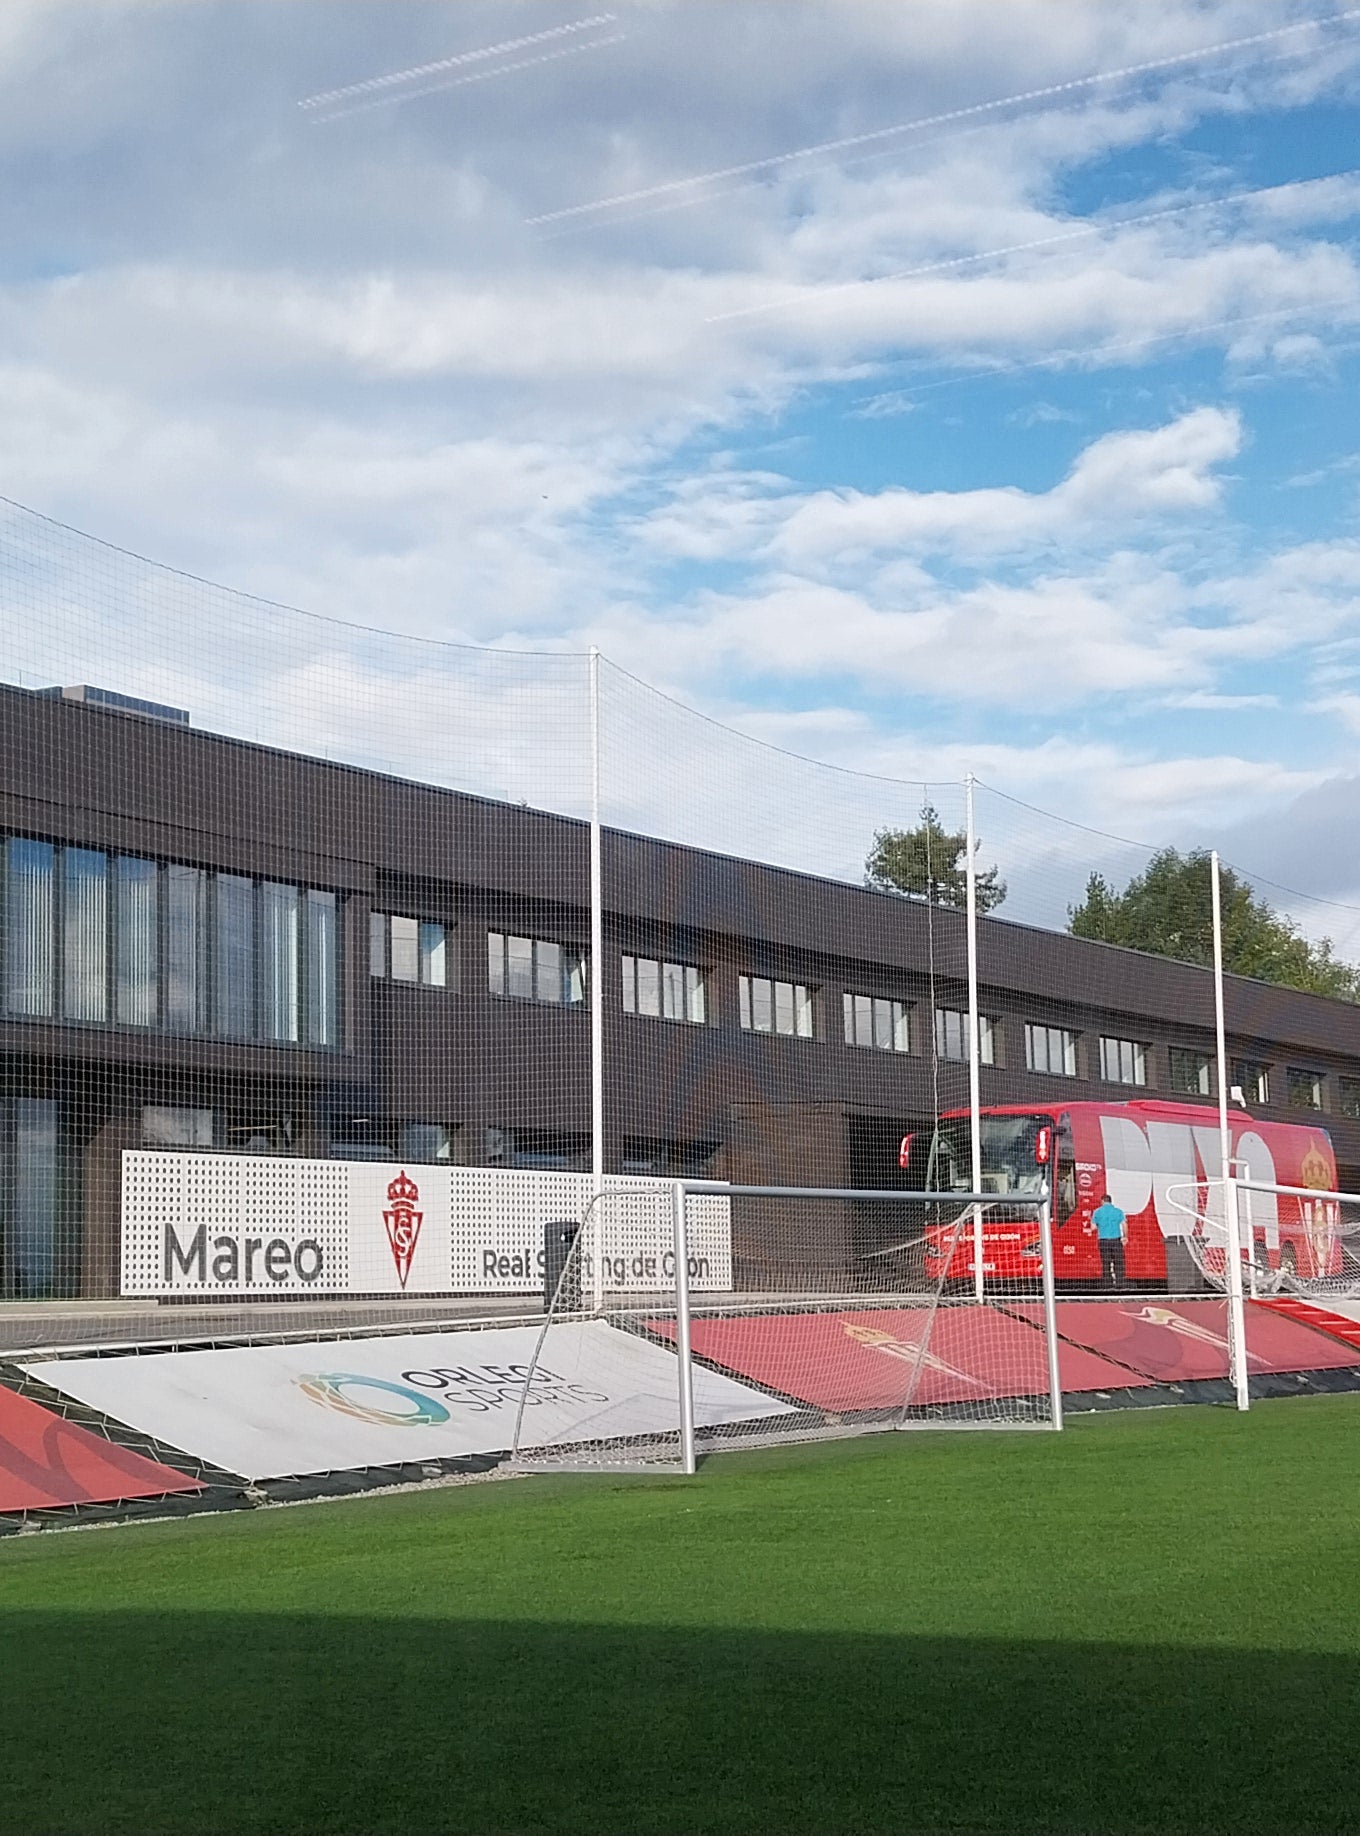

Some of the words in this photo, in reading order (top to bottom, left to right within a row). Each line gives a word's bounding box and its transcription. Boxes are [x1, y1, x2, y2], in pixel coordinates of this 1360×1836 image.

[163, 1223, 323, 1283] Mareo
[482, 1248, 530, 1279] Real
[632, 1248, 657, 1279] de
[401, 1364, 567, 1389] ORLEGI
[444, 1384, 610, 1412] SPORTS
